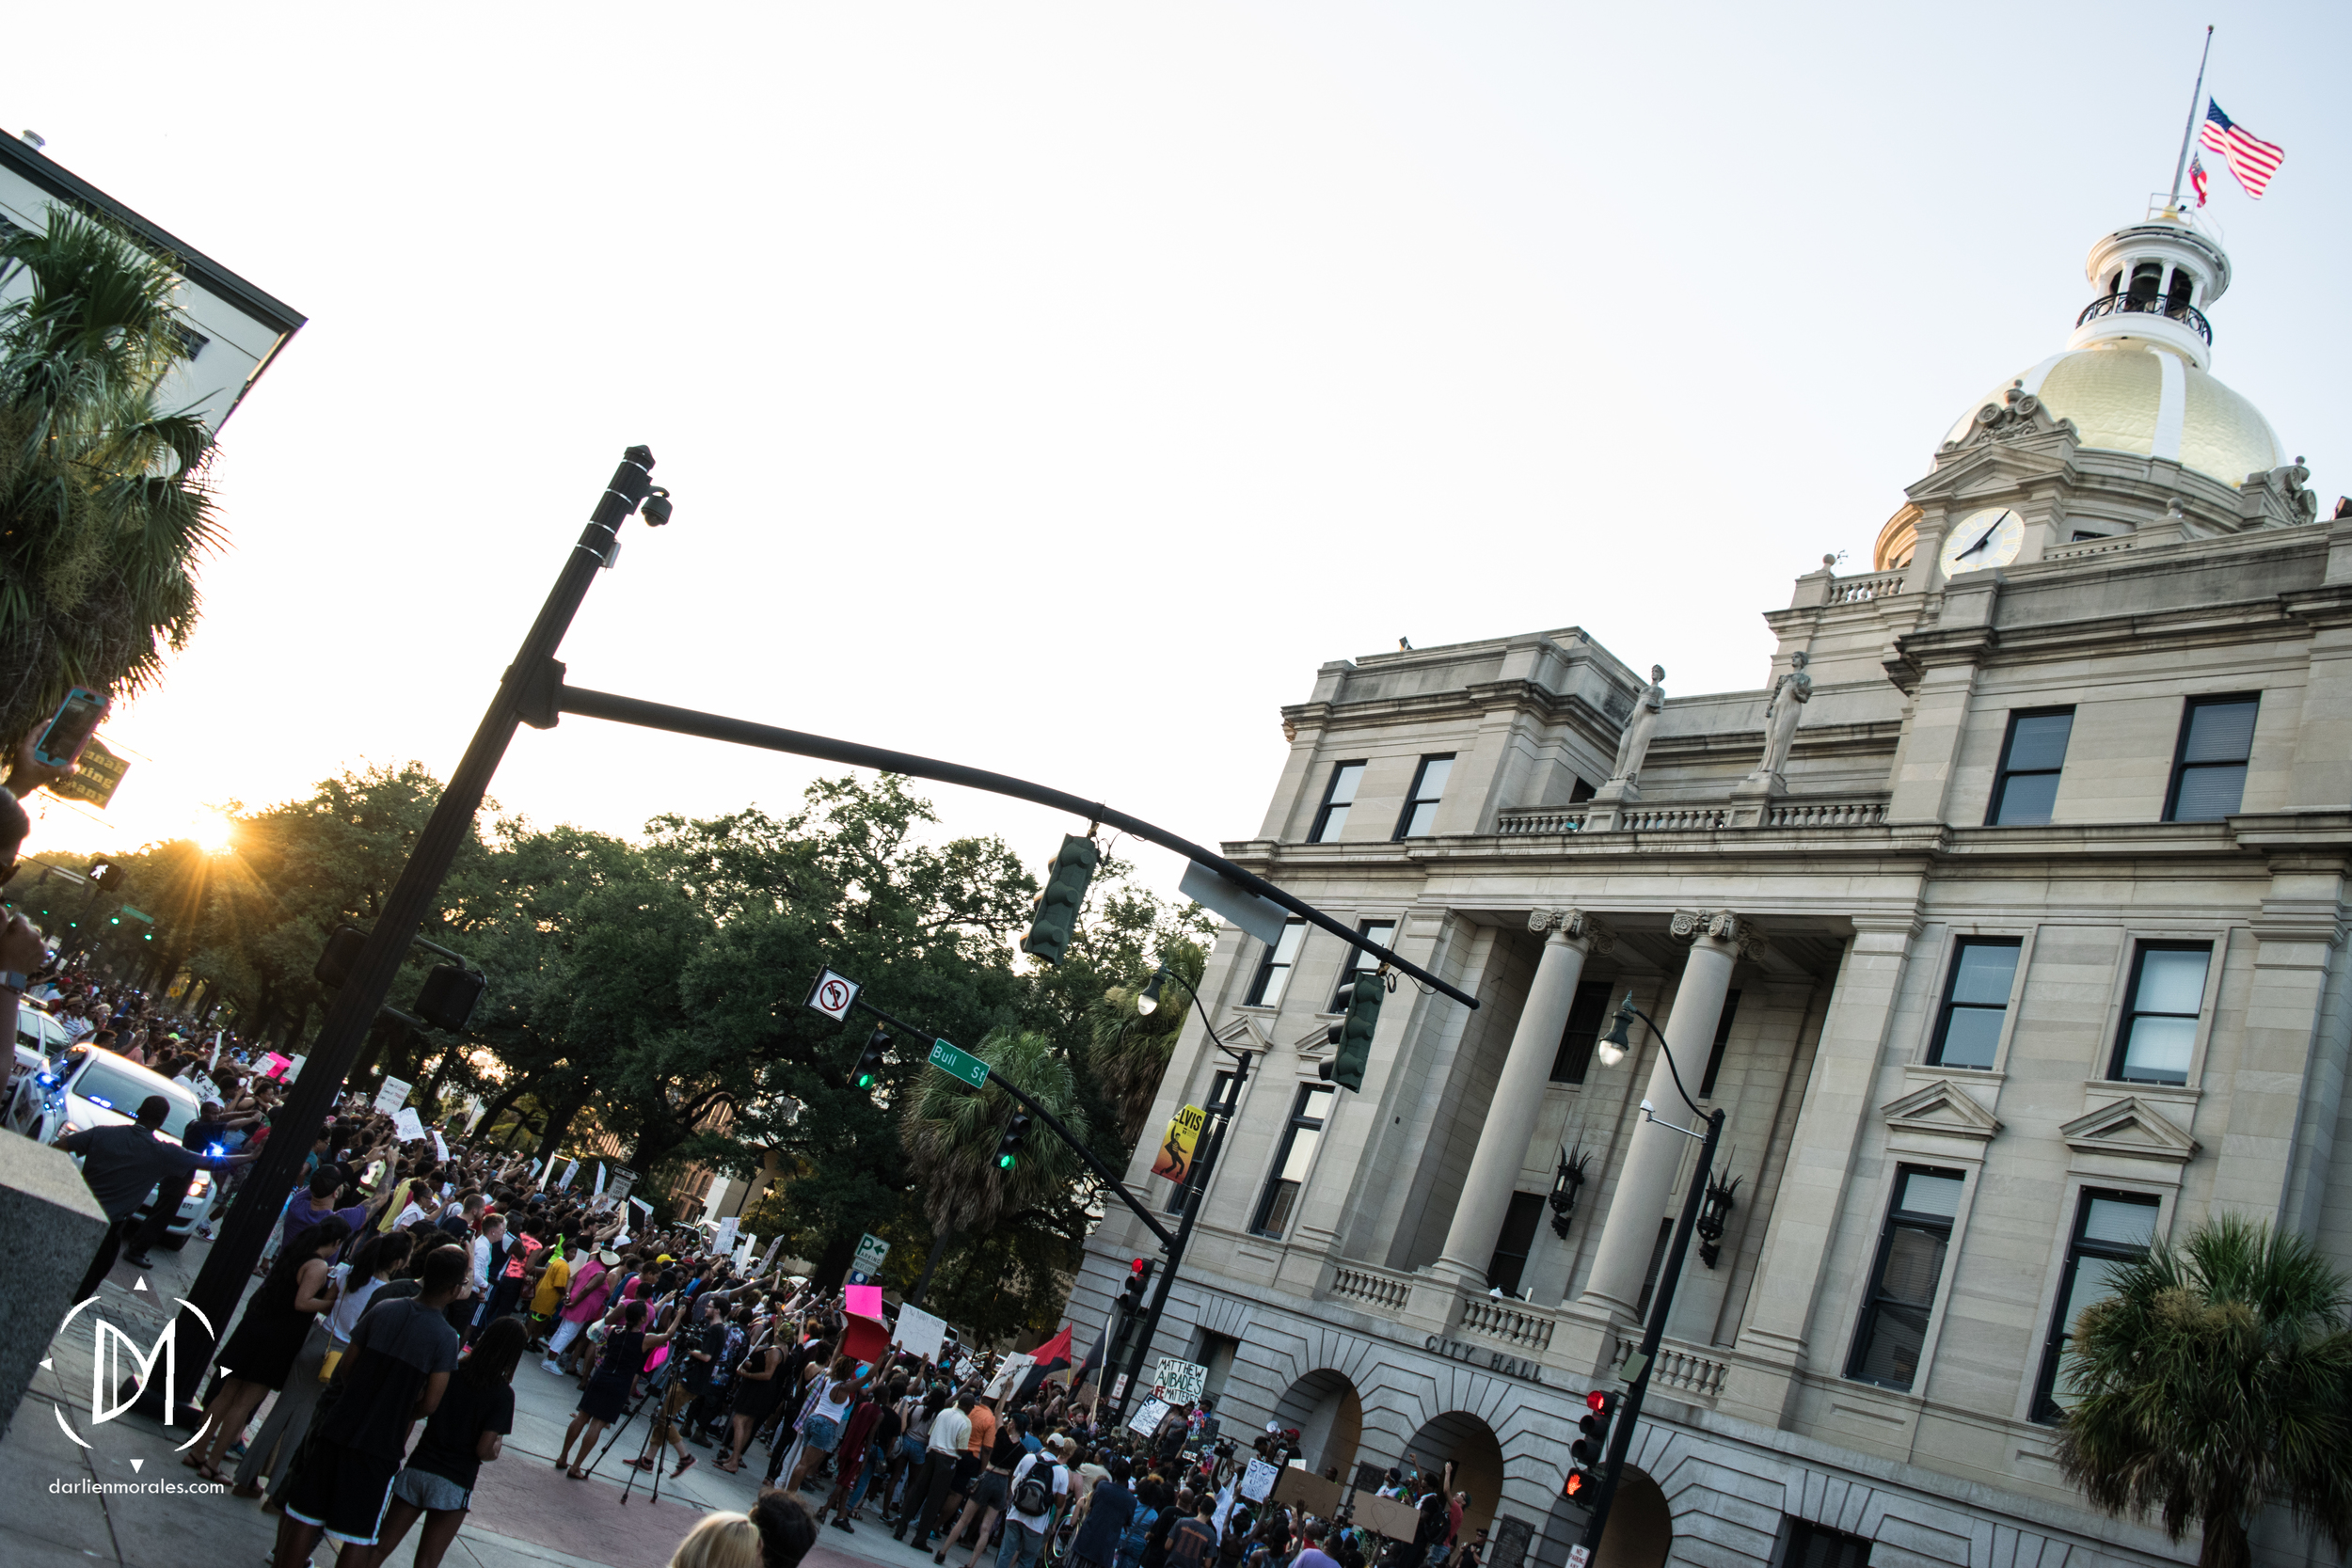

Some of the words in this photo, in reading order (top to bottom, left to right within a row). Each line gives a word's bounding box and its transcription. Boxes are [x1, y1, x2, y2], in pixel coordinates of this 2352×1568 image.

[932, 1045, 958, 1067] Bull
[971, 1066, 986, 1083] St
[855, 1261, 865, 1271] NEXT
[864, 1264, 875, 1275] LEFT
[1157, 1358, 1205, 1379] MATTHEW
[1424, 1335, 1475, 1361] CITY
[1490, 1353, 1542, 1383] HALL
[1154, 1370, 1202, 1395] AJIBADE'S
[1164, 1387, 1200, 1407] MATTERED
[1247, 1471, 1270, 1485] KILLING
[1249, 1460, 1277, 1476] STOP
[1568, 1553, 1585, 1565] PARKING
